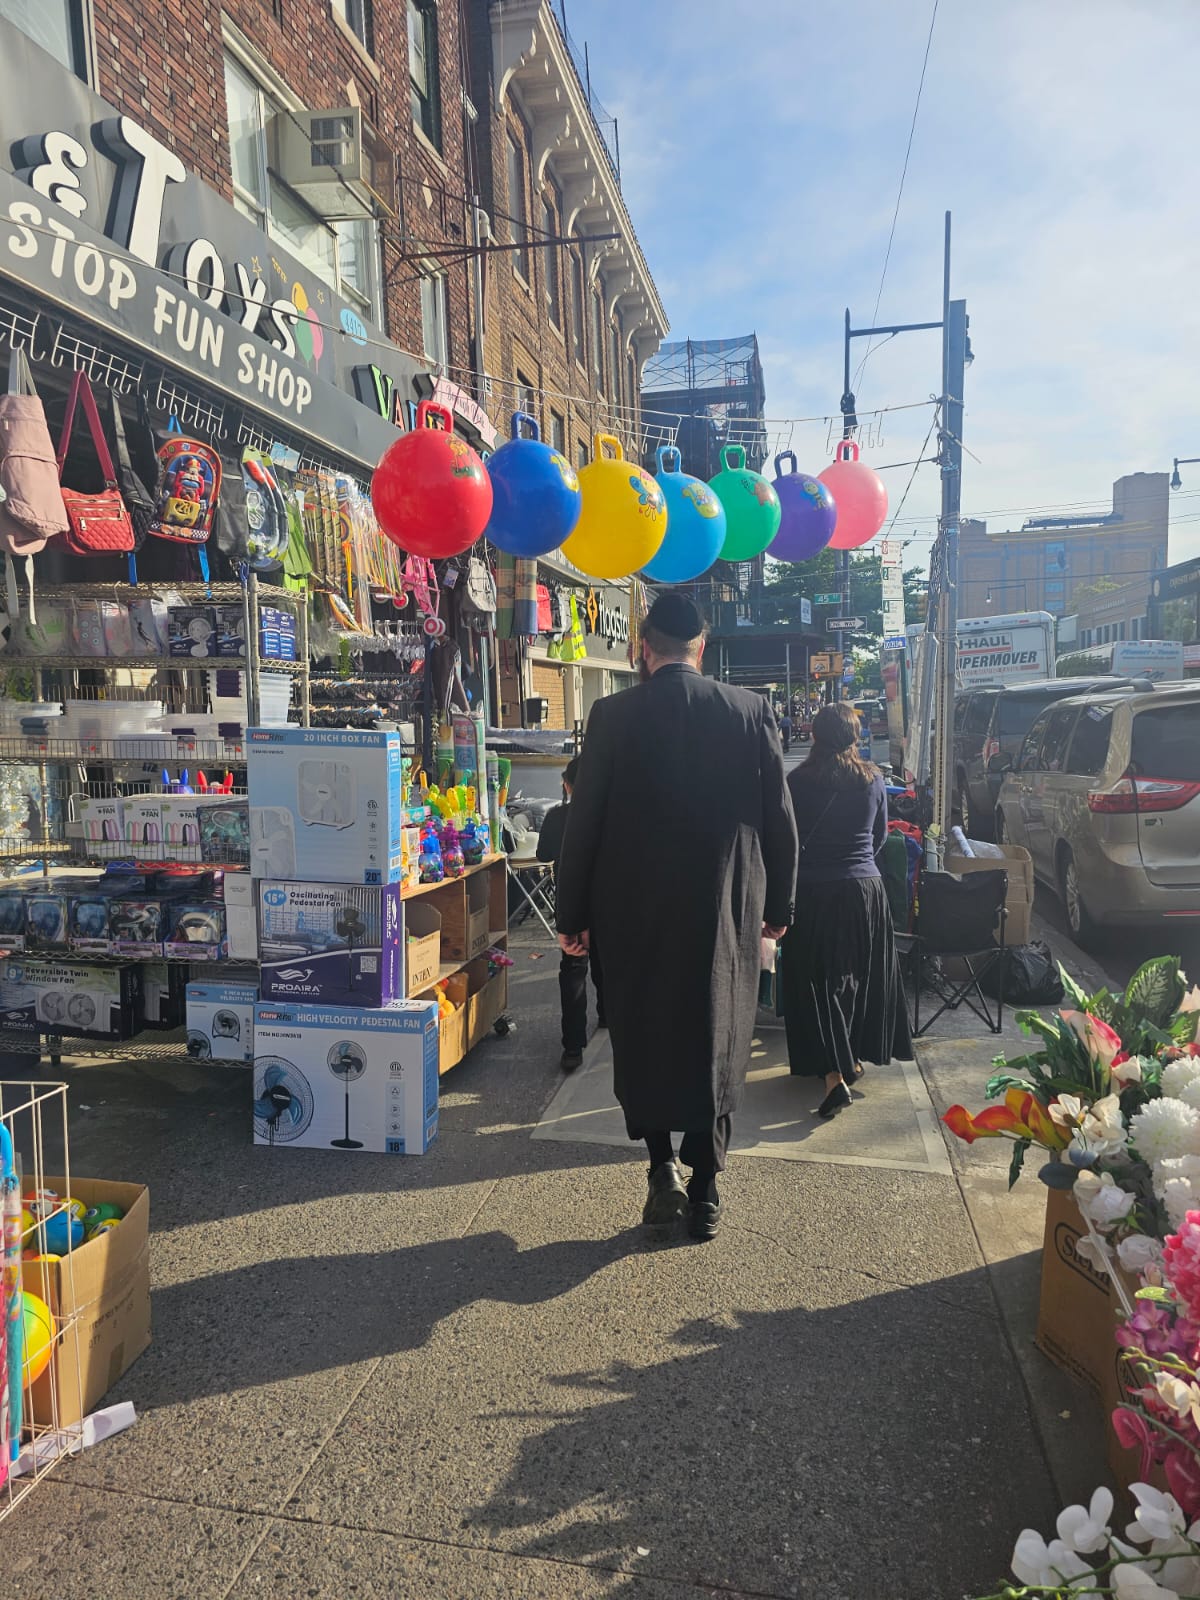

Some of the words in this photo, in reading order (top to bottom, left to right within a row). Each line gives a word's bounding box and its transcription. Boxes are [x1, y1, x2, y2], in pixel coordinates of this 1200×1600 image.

[8, 201, 138, 310] STOP
[153, 285, 225, 368] FUN
[237, 342, 313, 414] SHOP
[817, 595, 829, 603] 45
[304, 733, 315, 742] 20
[317, 733, 340, 743] INCH
[341, 734, 360, 743] BOX
[362, 735, 380, 744] FAN
[289, 891, 337, 901] Oscillating
[289, 898, 325, 908] Pedestal
[325, 900, 341, 908] Fan
[25, 966, 69, 976] Reversible
[69, 969, 89, 978] Twin
[25, 974, 60, 983] Window
[60, 976, 75, 985] Fan
[271, 982, 321, 993] PROAIRA
[297, 1014, 318, 1024] HIGH
[319, 1015, 359, 1026] VELOCITY
[361, 1017, 402, 1028] PEDESTAL
[403, 1018, 421, 1029] FAN
